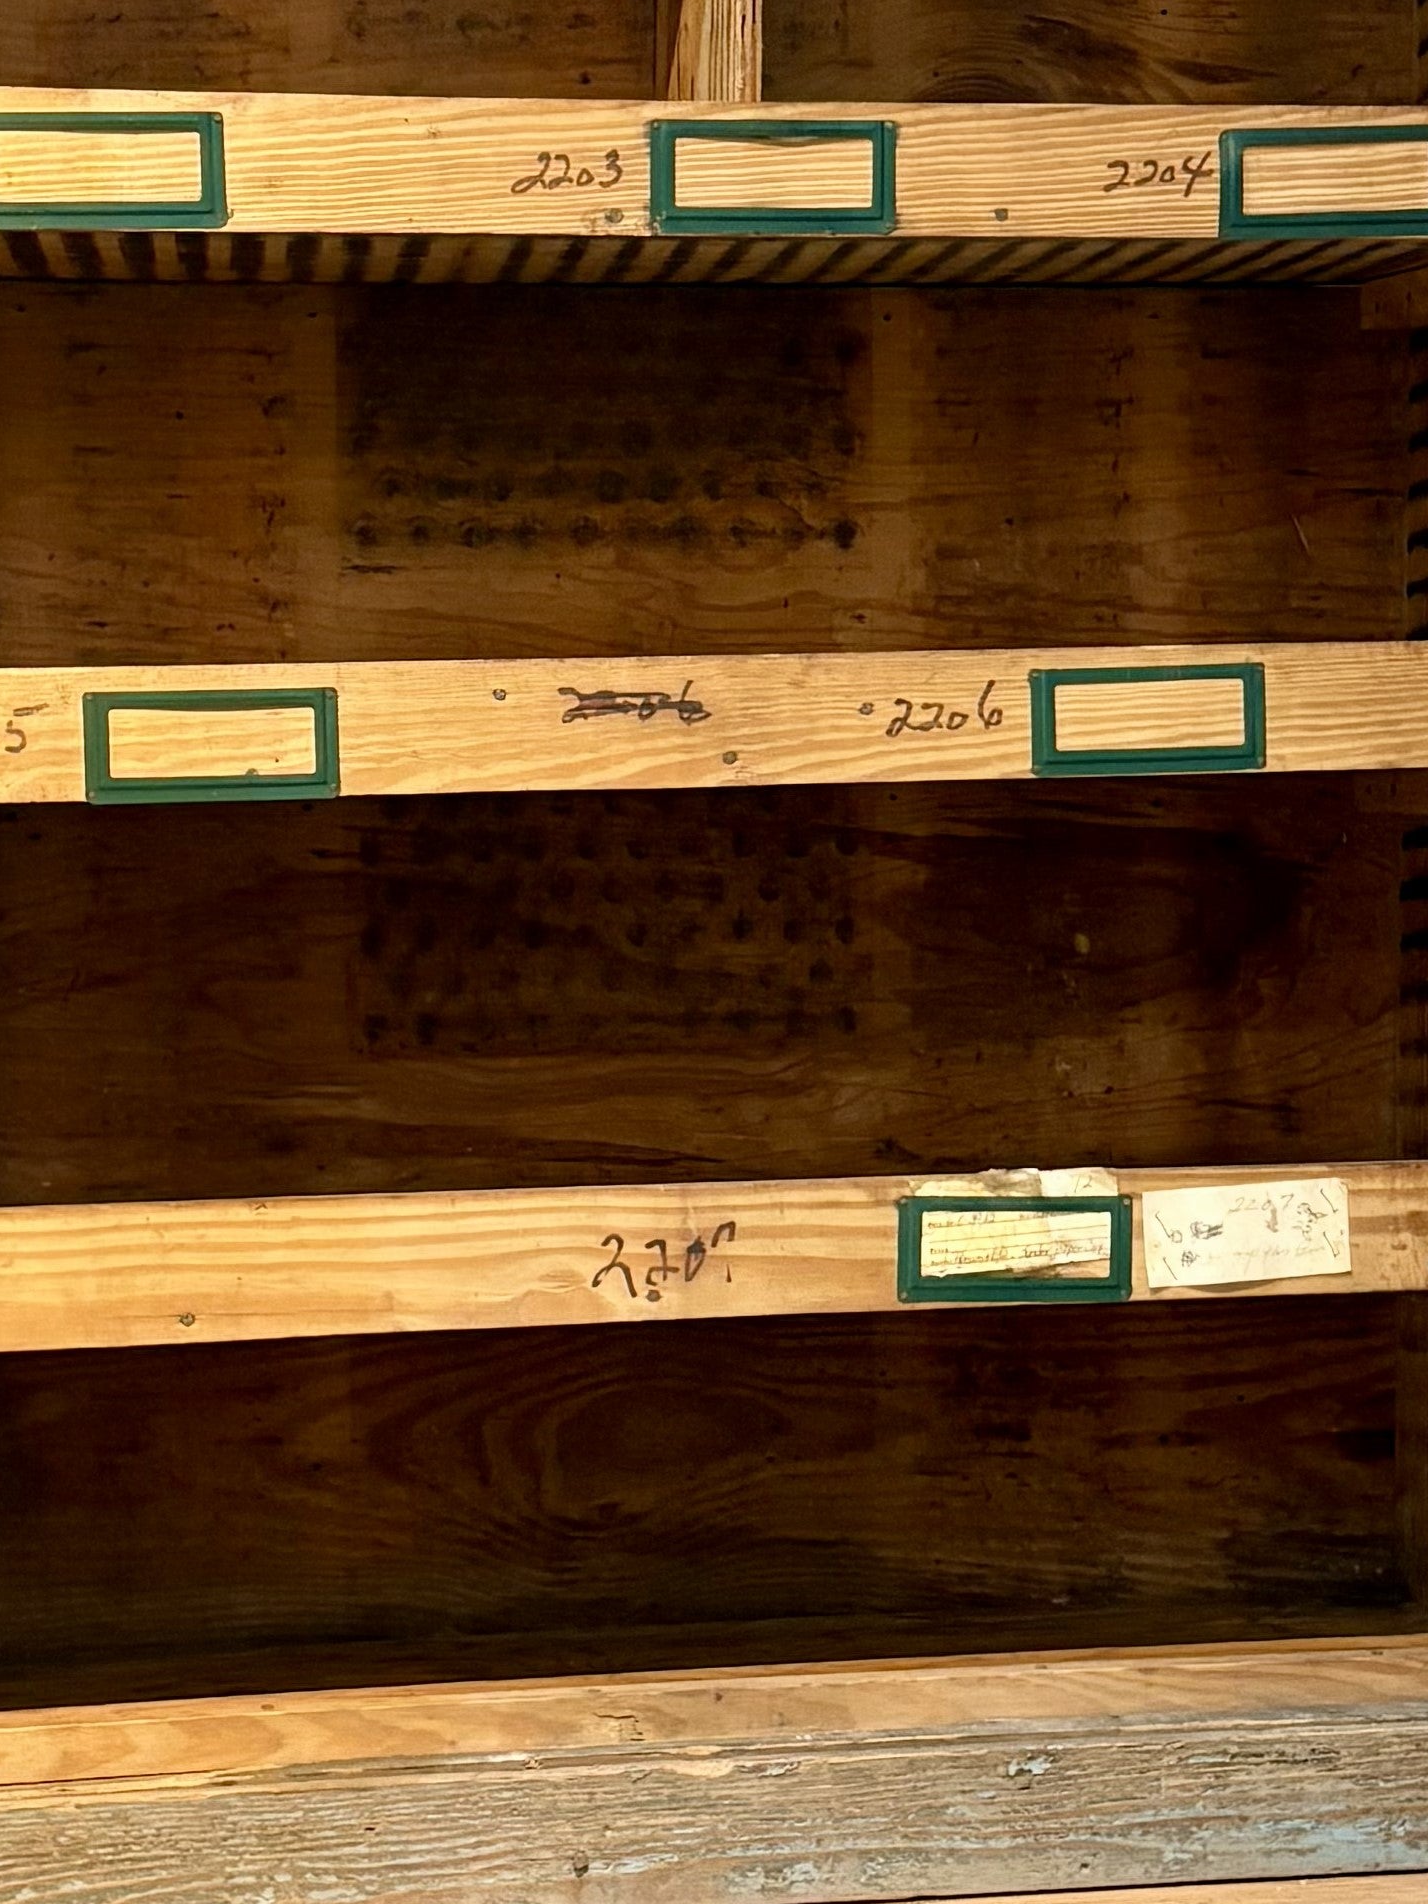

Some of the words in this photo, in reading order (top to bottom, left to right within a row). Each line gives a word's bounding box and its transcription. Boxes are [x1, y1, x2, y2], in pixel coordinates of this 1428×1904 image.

[510, 148, 625, 195] 2203
[1102, 150, 1217, 198] 2204
[885, 679, 1005, 739] 2206
